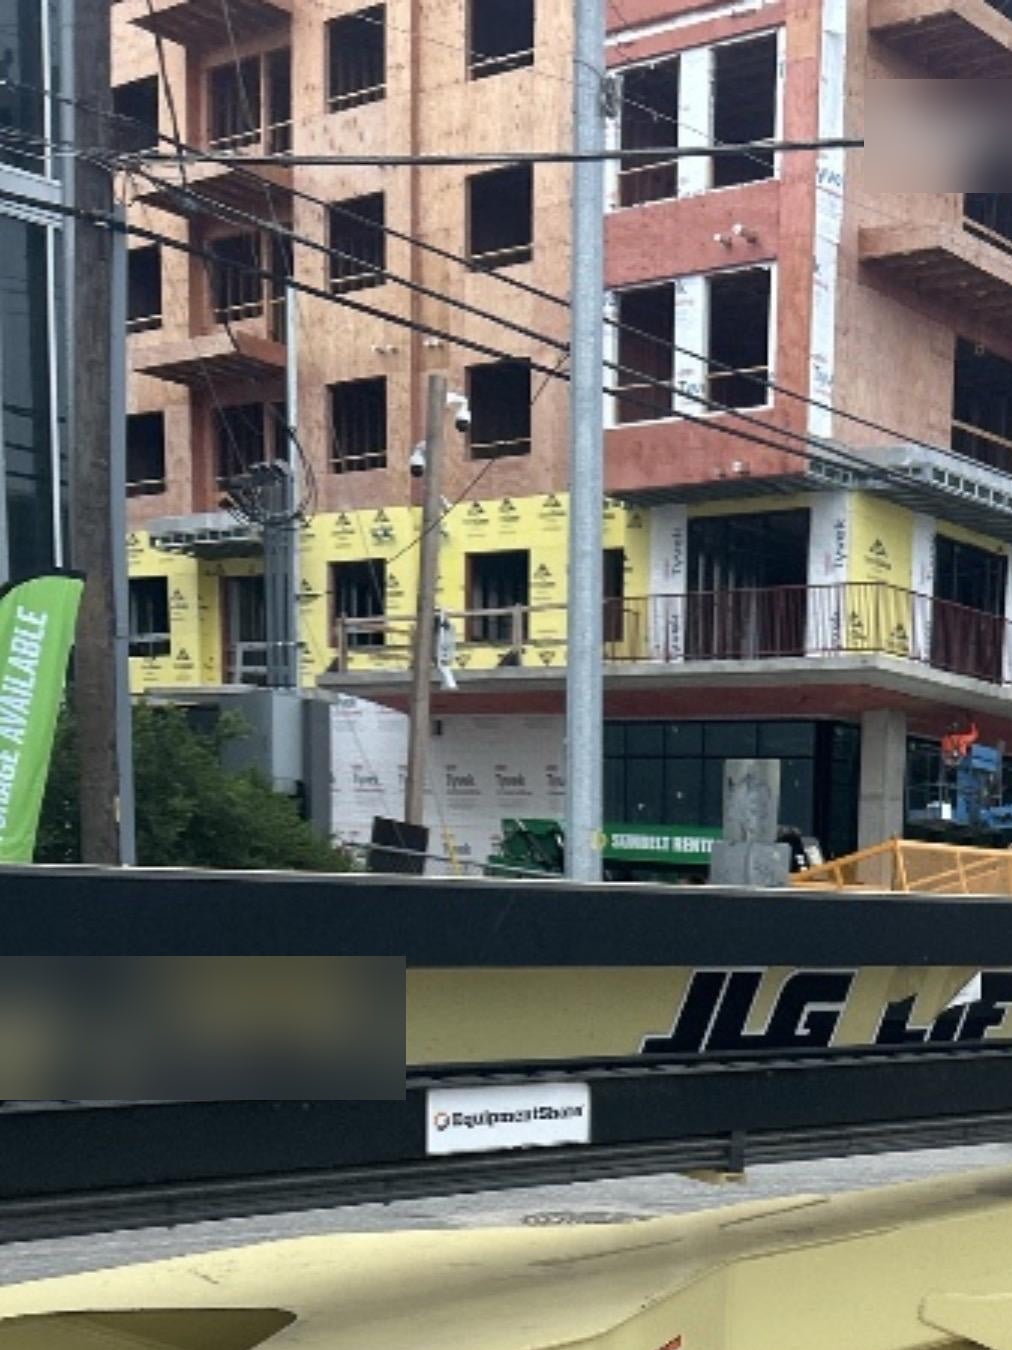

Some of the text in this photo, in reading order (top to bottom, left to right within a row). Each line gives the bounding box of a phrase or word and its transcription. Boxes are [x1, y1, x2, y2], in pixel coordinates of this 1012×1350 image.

[0, 606, 48, 744] AVAILABLE
[446, 774, 475, 788] Tyvek
[638, 968, 859, 1053] JLG
[452, 1106, 583, 1129] EquipmentShare
